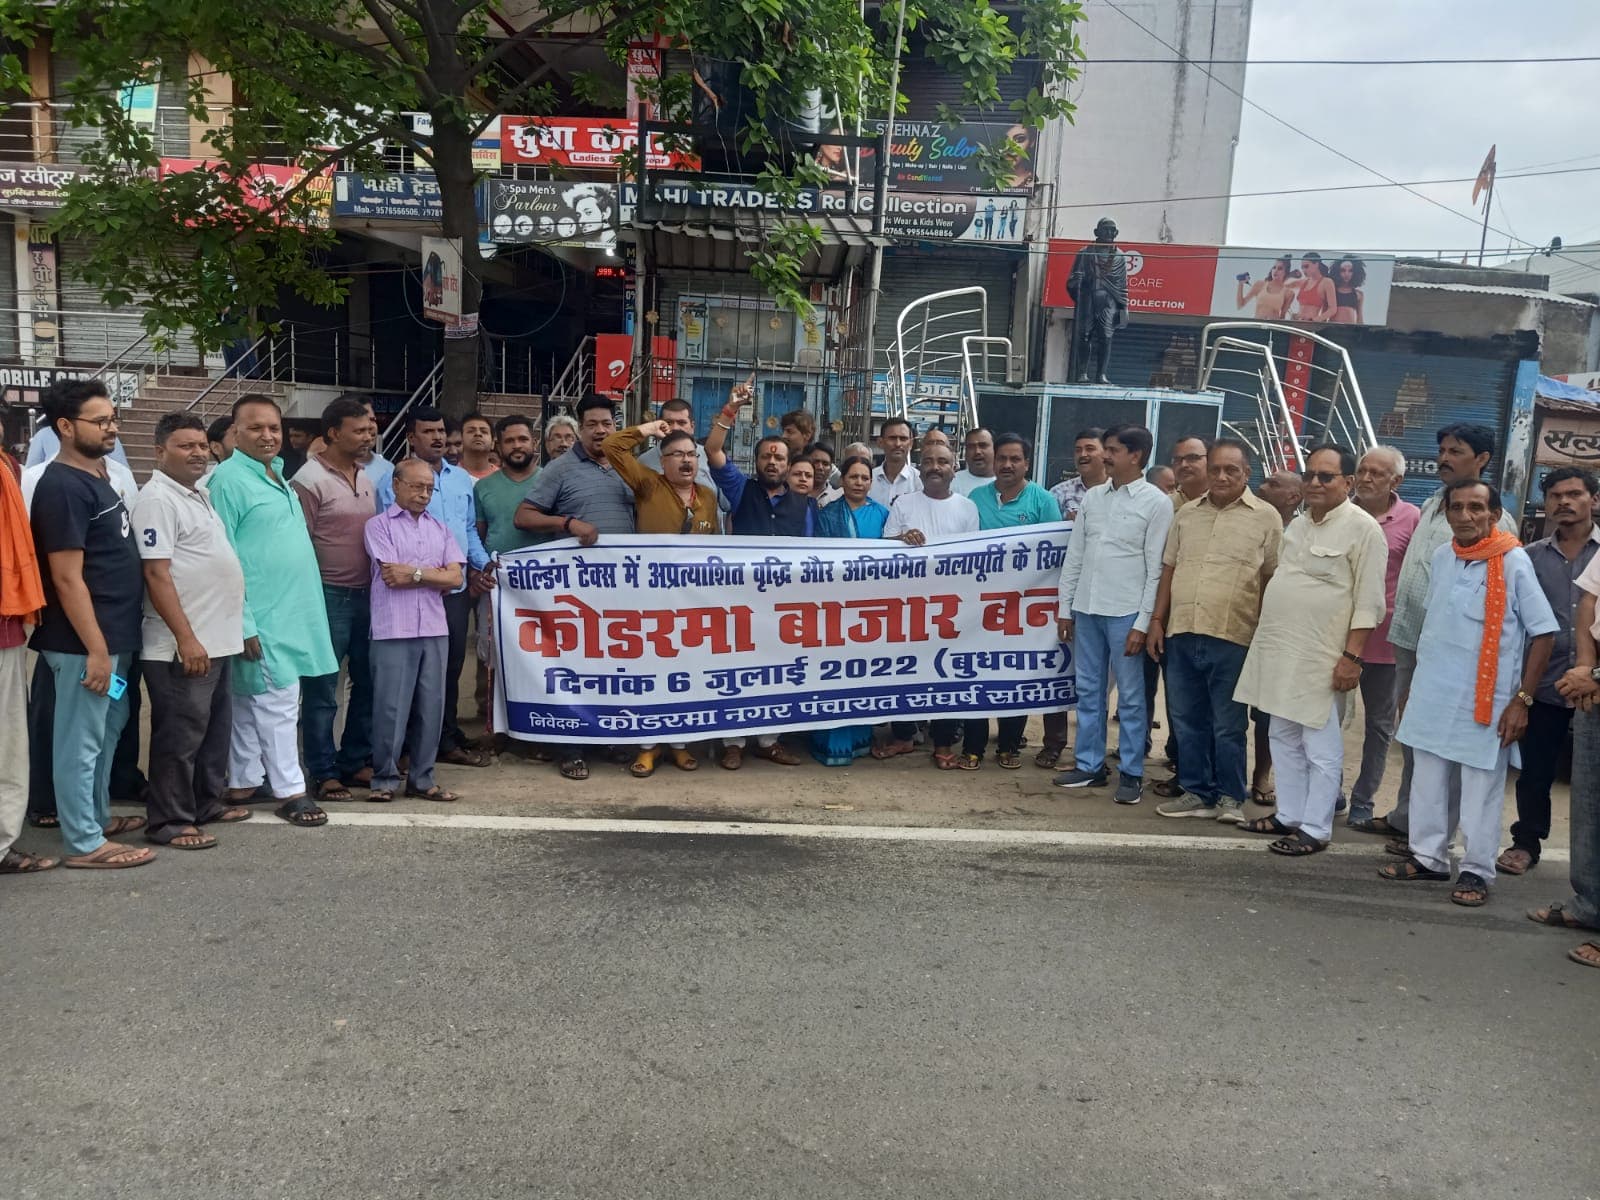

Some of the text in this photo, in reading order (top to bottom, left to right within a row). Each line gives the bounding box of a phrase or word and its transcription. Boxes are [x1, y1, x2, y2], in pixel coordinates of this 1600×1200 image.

[876, 123, 941, 138] SEHNAZ
[573, 154, 595, 162] Ladies
[509, 184, 556, 195] Spa Men's
[625, 187, 688, 205] MHI
[494, 194, 560, 211] Parlour
[859, 195, 967, 214] Cllection
[919, 217, 934, 227] Kids
[1126, 277, 1164, 288] CARE
[0, 368, 51, 388] OBILE
[143, 528, 157, 547] 3
[507, 558, 570, 590] होल्डिंग
[575, 555, 617, 588] टैक्स
[622, 554, 641, 588] में
[648, 556, 745, 590] अप्रत्याशित
[751, 556, 792, 593] वृद्धि
[800, 555, 834, 584] और
[842, 554, 928, 582] अनियमित
[933, 541, 1006, 583] जलापूर्ति
[1012, 542, 1031, 571] के
[515, 594, 756, 659] कोडरमा
[774, 593, 963, 649] बाजार
[544, 643, 1072, 697] दिनांक 6 जुलाई 2022 (बुधवार)
[598, 709, 718, 731] कोडरमा
[725, 702, 793, 720] नगर
[799, 695, 900, 717] पंचायत
[905, 684, 983, 708] संघर्ष
[986, 679, 1076, 705] समिति
